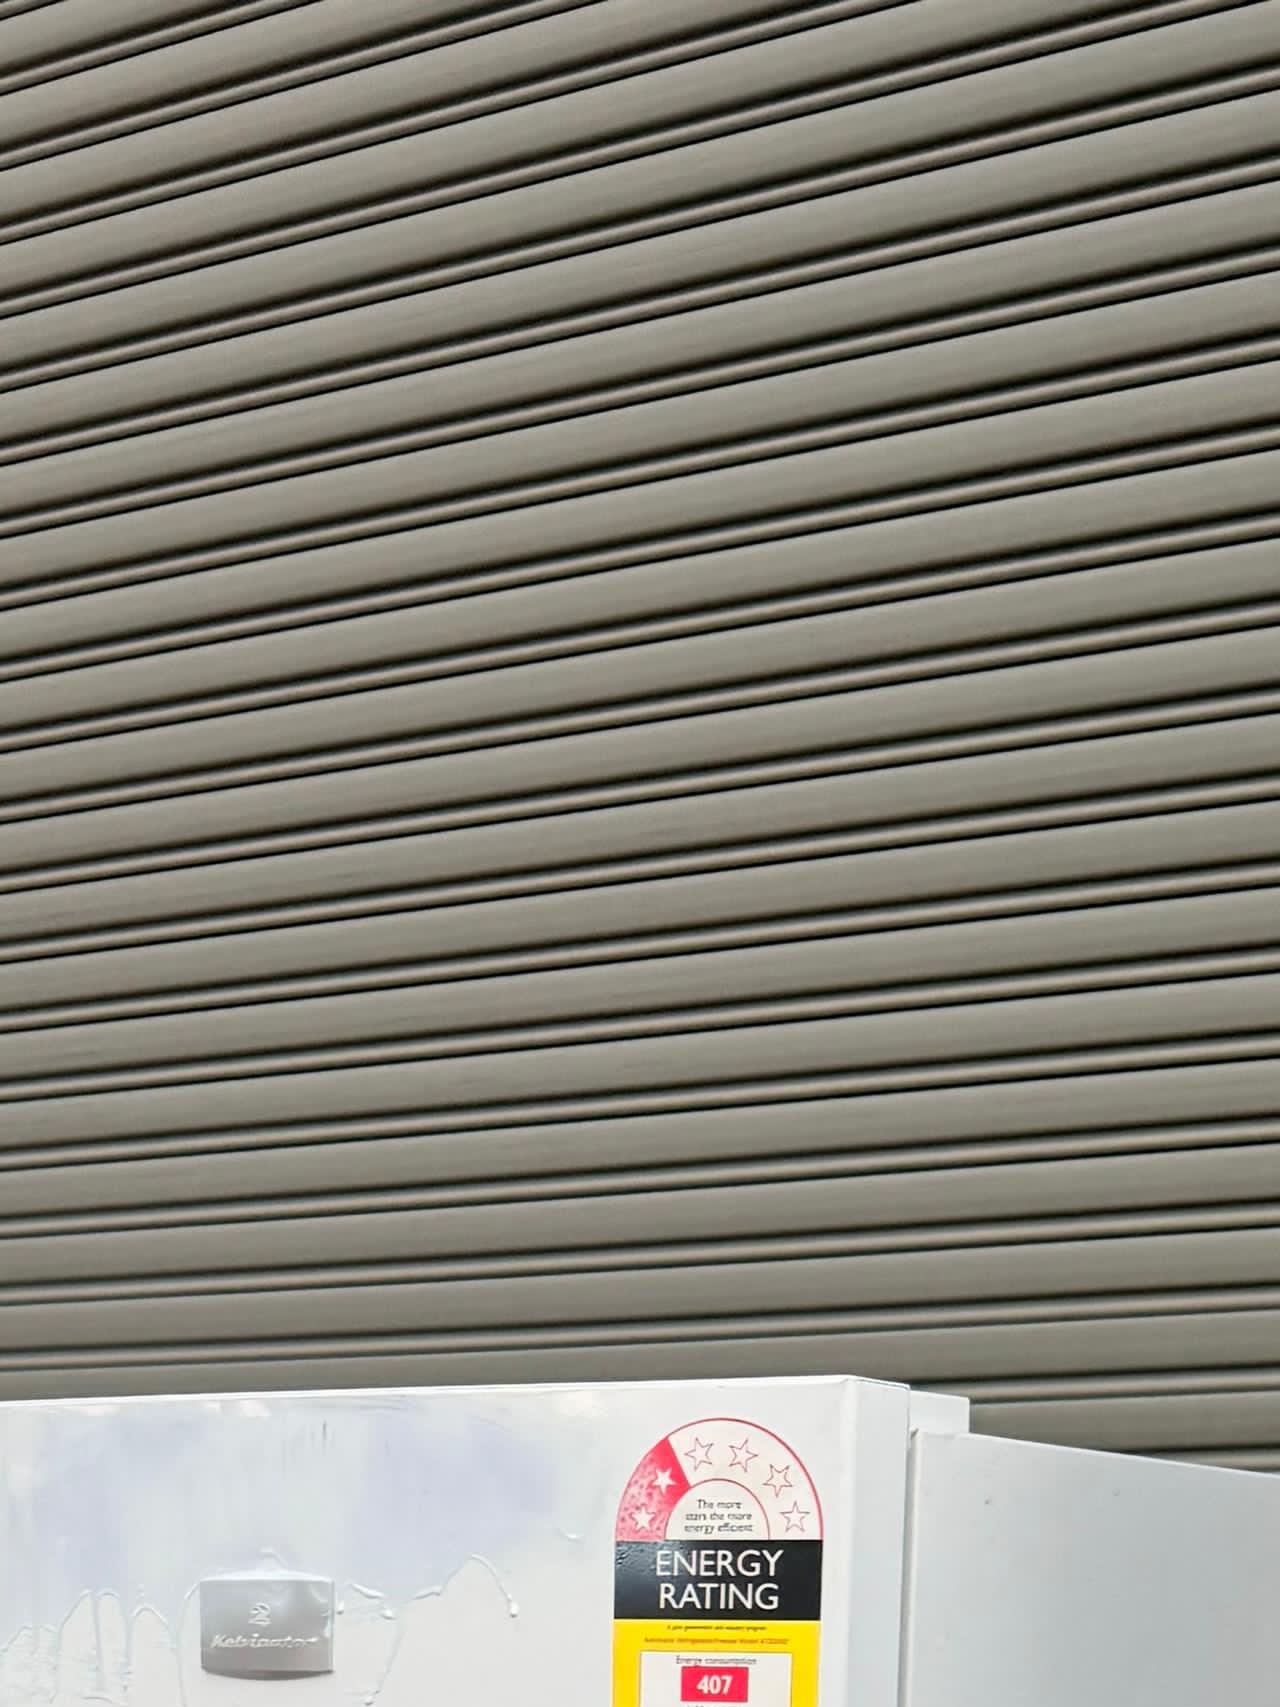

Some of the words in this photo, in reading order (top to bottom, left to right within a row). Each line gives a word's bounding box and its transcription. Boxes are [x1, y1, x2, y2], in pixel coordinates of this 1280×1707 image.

[697, 1499, 714, 1509] The
[655, 1549, 785, 1578] ENERGY
[658, 1583, 779, 1611] RATING
[696, 1674, 733, 1695] 407
